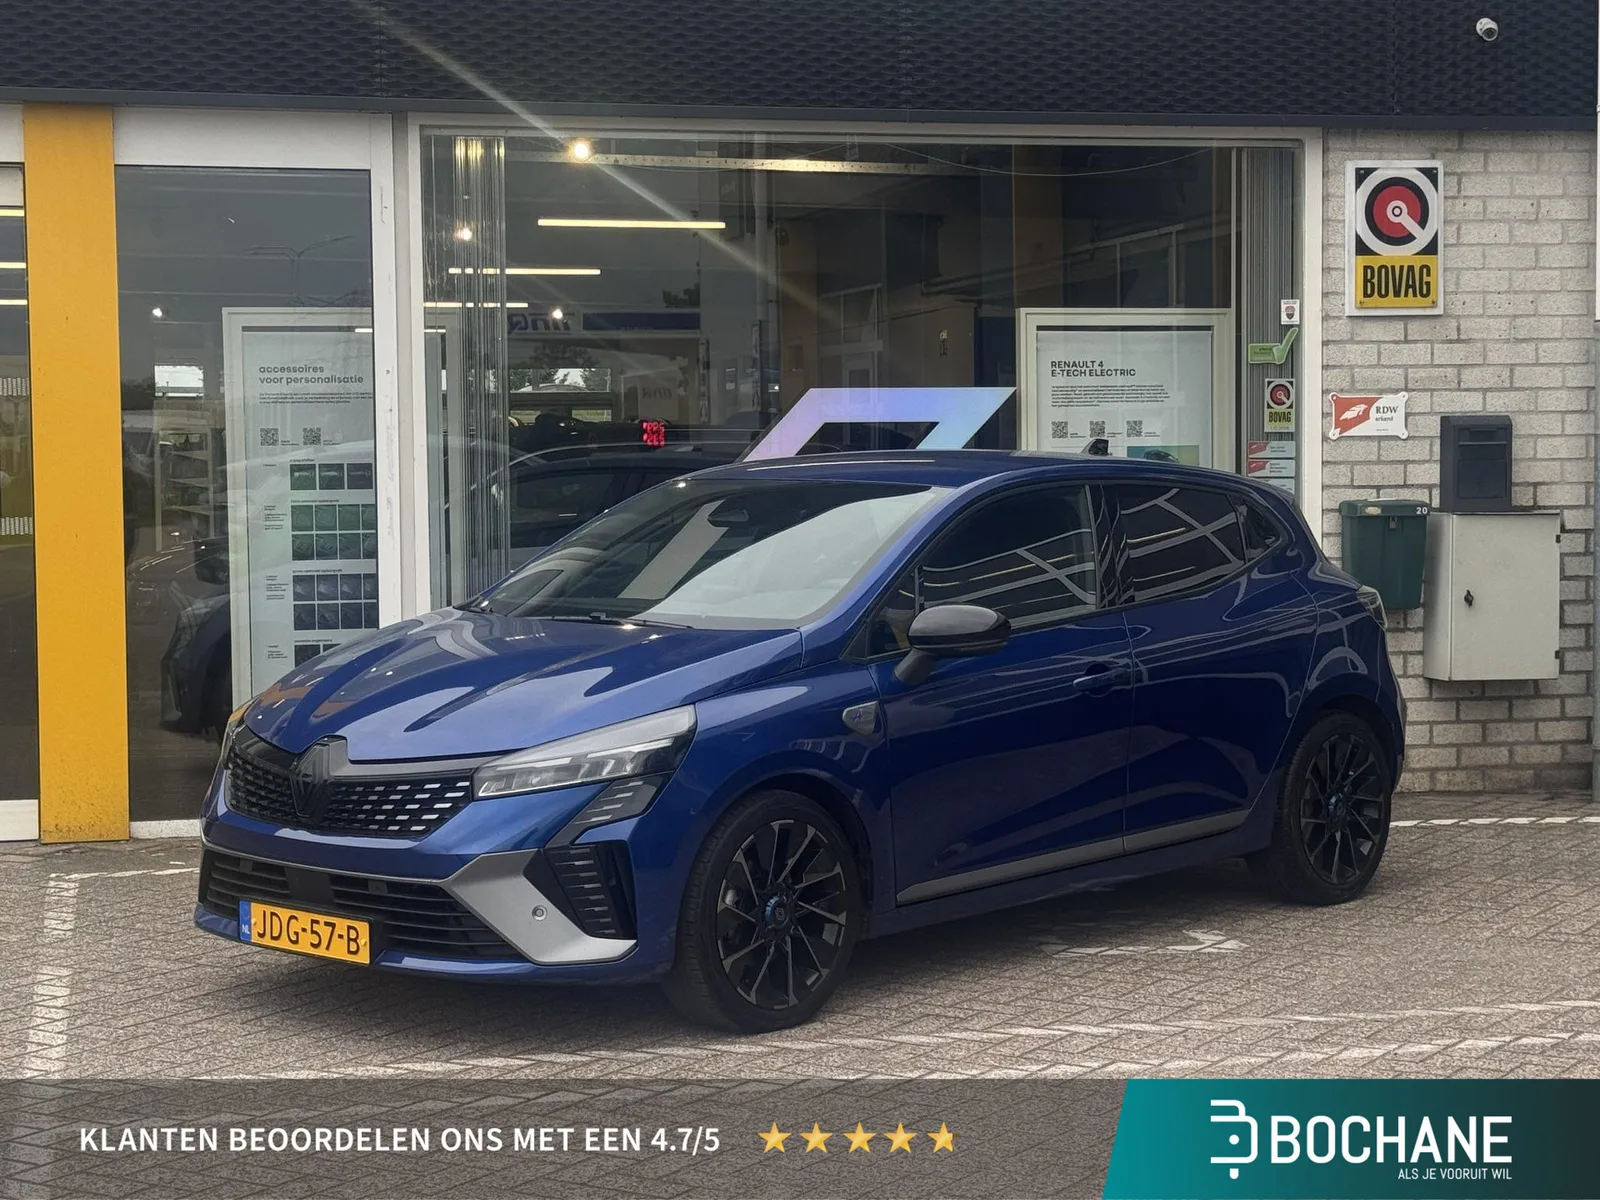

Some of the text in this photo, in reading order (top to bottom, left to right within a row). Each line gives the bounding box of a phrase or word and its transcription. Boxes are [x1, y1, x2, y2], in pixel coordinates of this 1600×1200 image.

[1363, 264, 1431, 298] BOVAG
[259, 364, 324, 373] accessoires
[1051, 368, 1136, 377] E-TECH ELECTRIC
[259, 375, 364, 386] voor personalisatie
[1375, 405, 1399, 414] RDW
[1268, 411, 1292, 423] BOVAG
[1416, 506, 1428, 515] 20
[241, 924, 250, 934] NL
[257, 910, 360, 955] JDG-57-B
